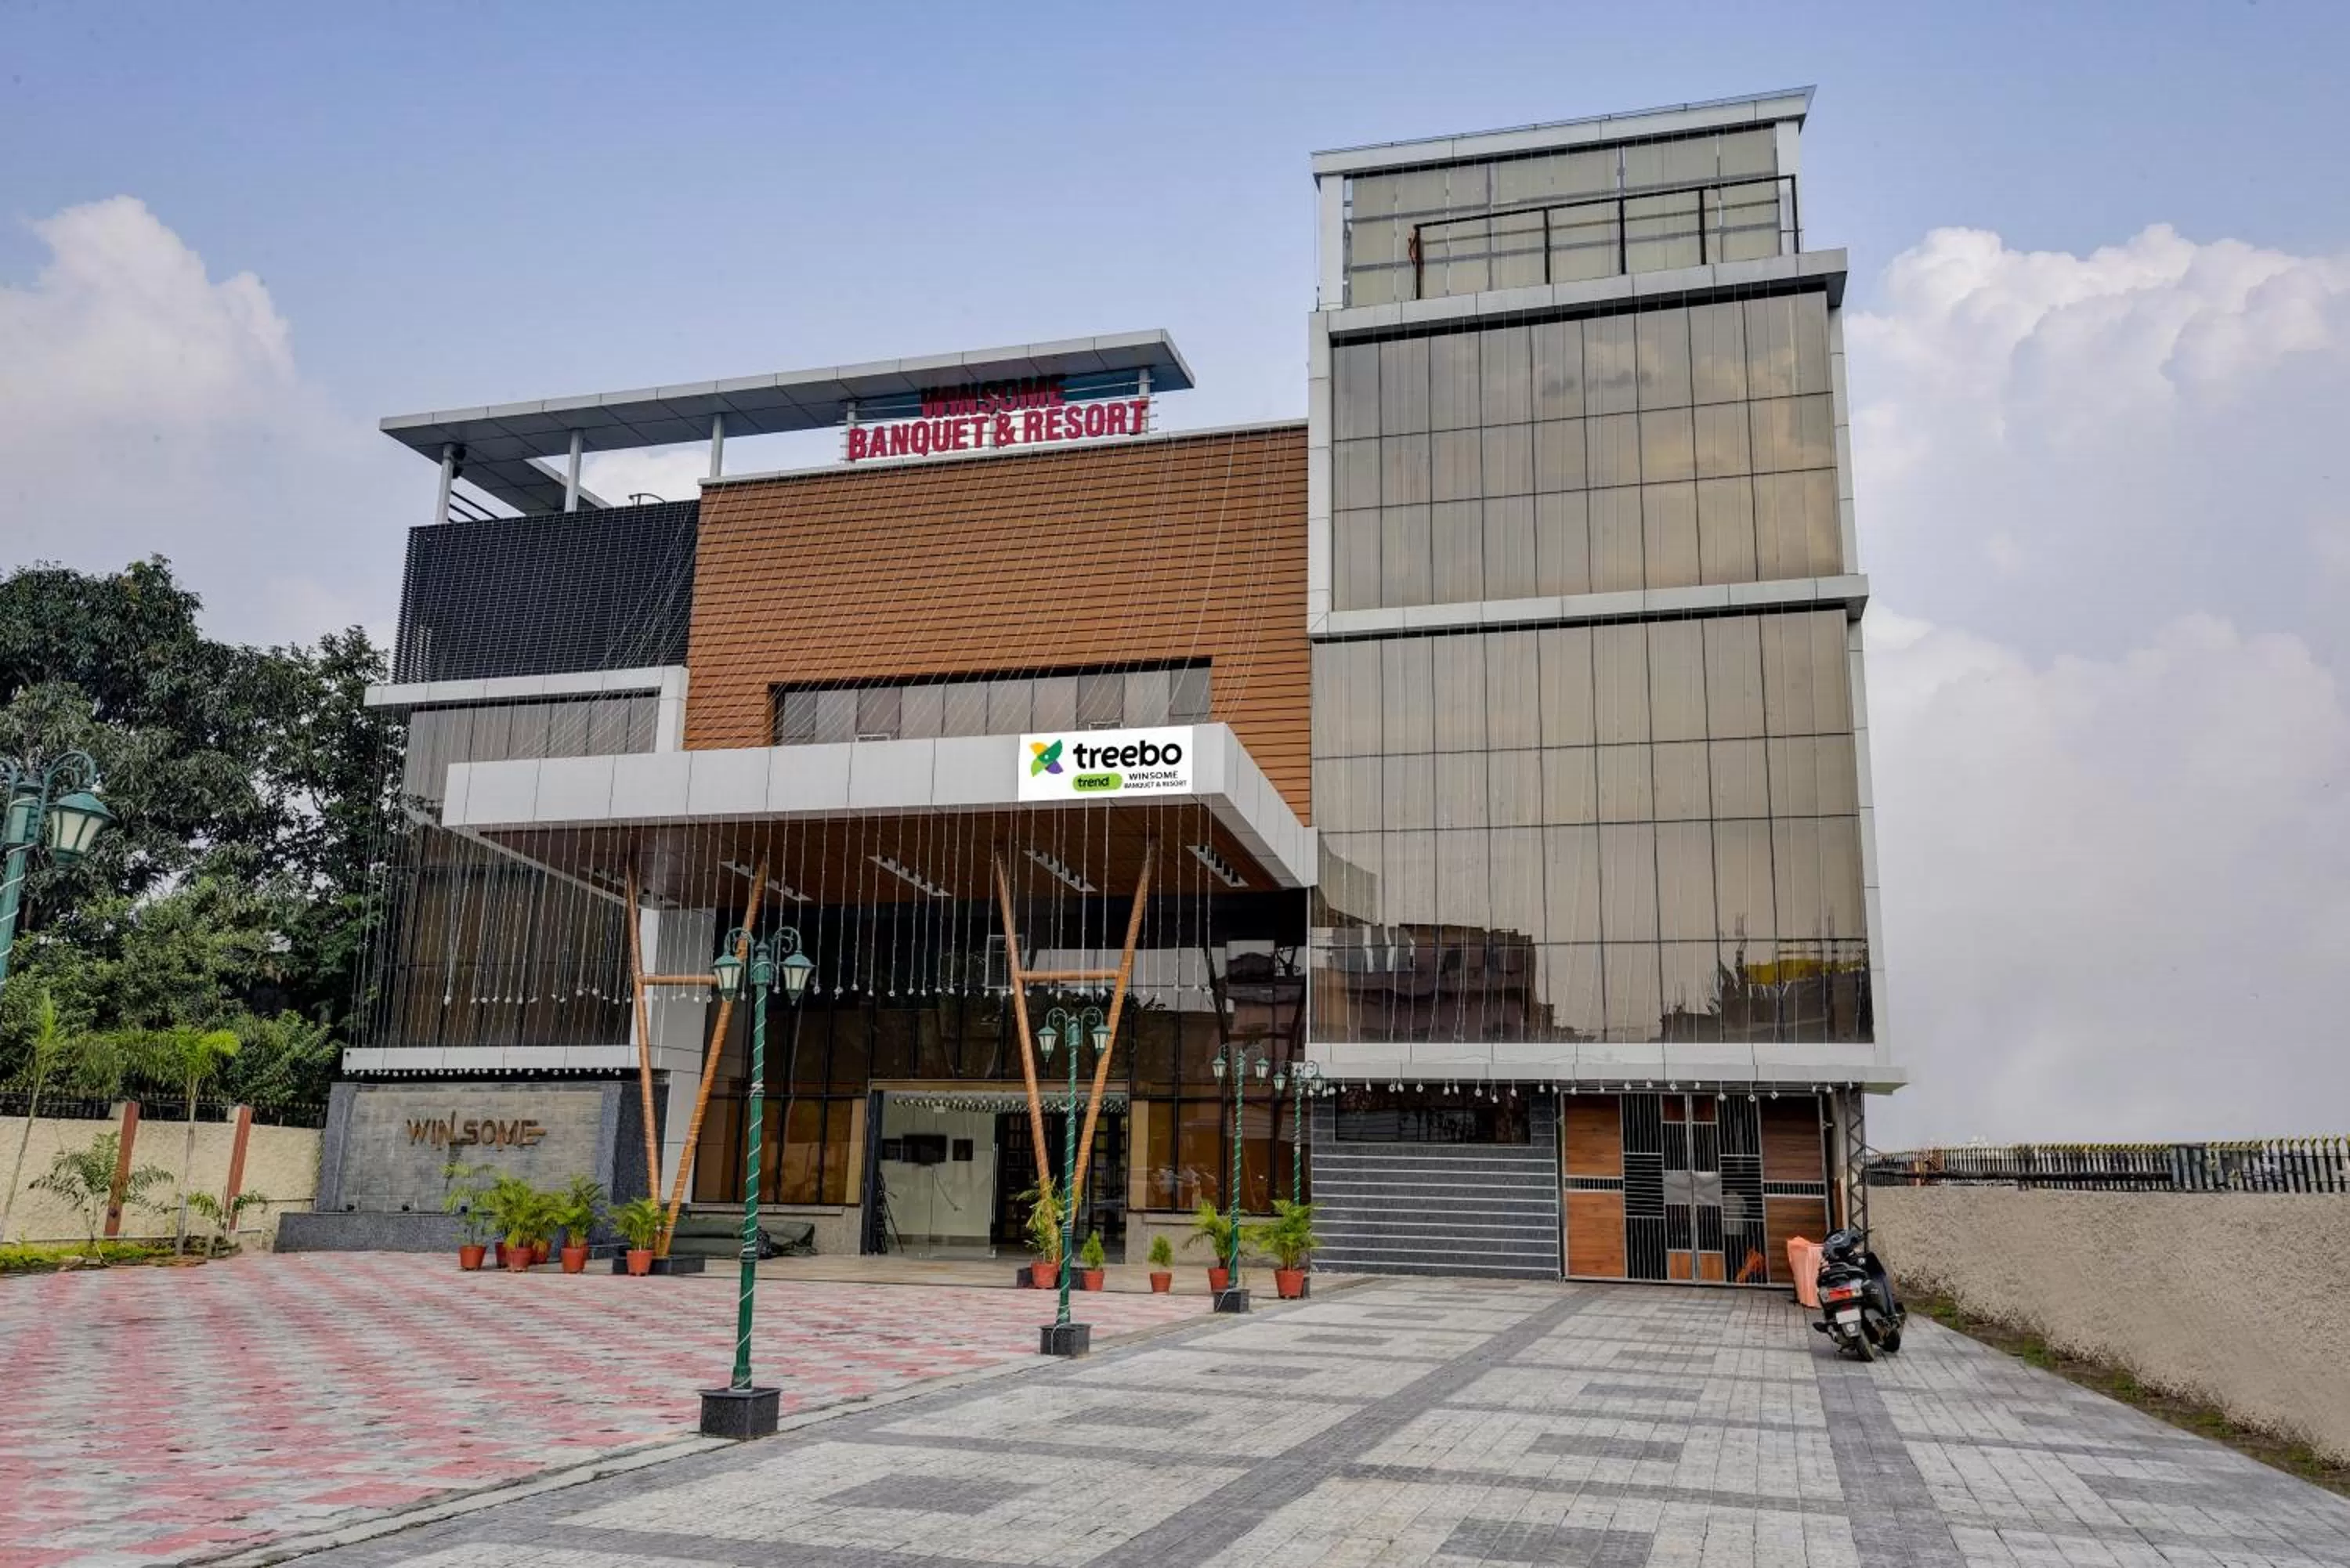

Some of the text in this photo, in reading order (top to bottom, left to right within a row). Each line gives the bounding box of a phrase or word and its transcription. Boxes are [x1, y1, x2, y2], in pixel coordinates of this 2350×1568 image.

[921, 375, 1066, 418] WINSOME
[848, 400, 1148, 461] BANQUET & RESORT
[1073, 740, 1182, 769] treebo
[1078, 776, 1109, 787] trend
[1129, 771, 1178, 780] WINSOME
[407, 1110, 547, 1151] WINSOME
